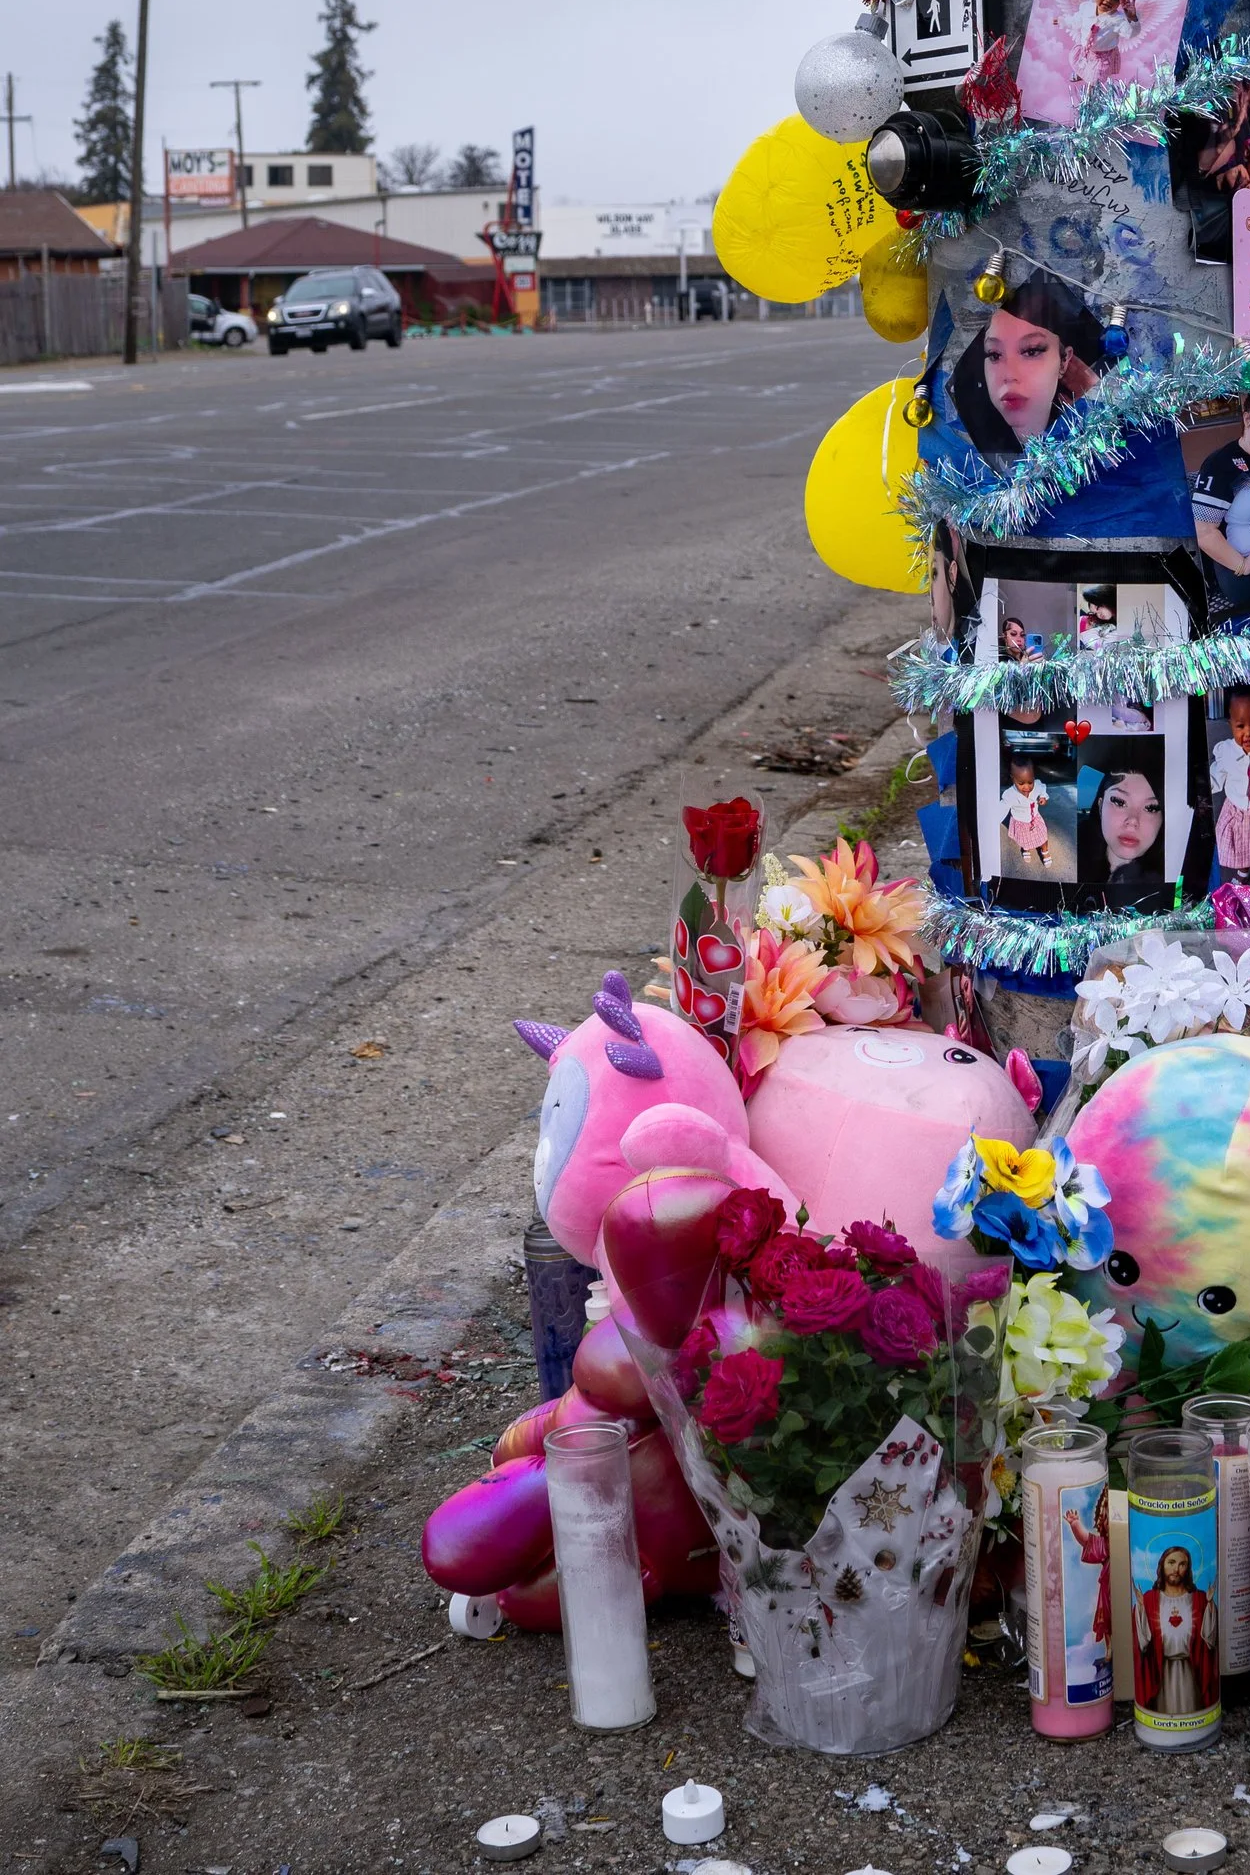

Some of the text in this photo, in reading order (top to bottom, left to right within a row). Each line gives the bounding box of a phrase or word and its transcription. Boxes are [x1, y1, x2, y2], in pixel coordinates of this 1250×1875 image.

[514, 131, 532, 225] MOTEL
[1138, 1496, 1209, 1510] Oración del Señor
[1153, 1717, 1206, 1728] Lord's Prayer
